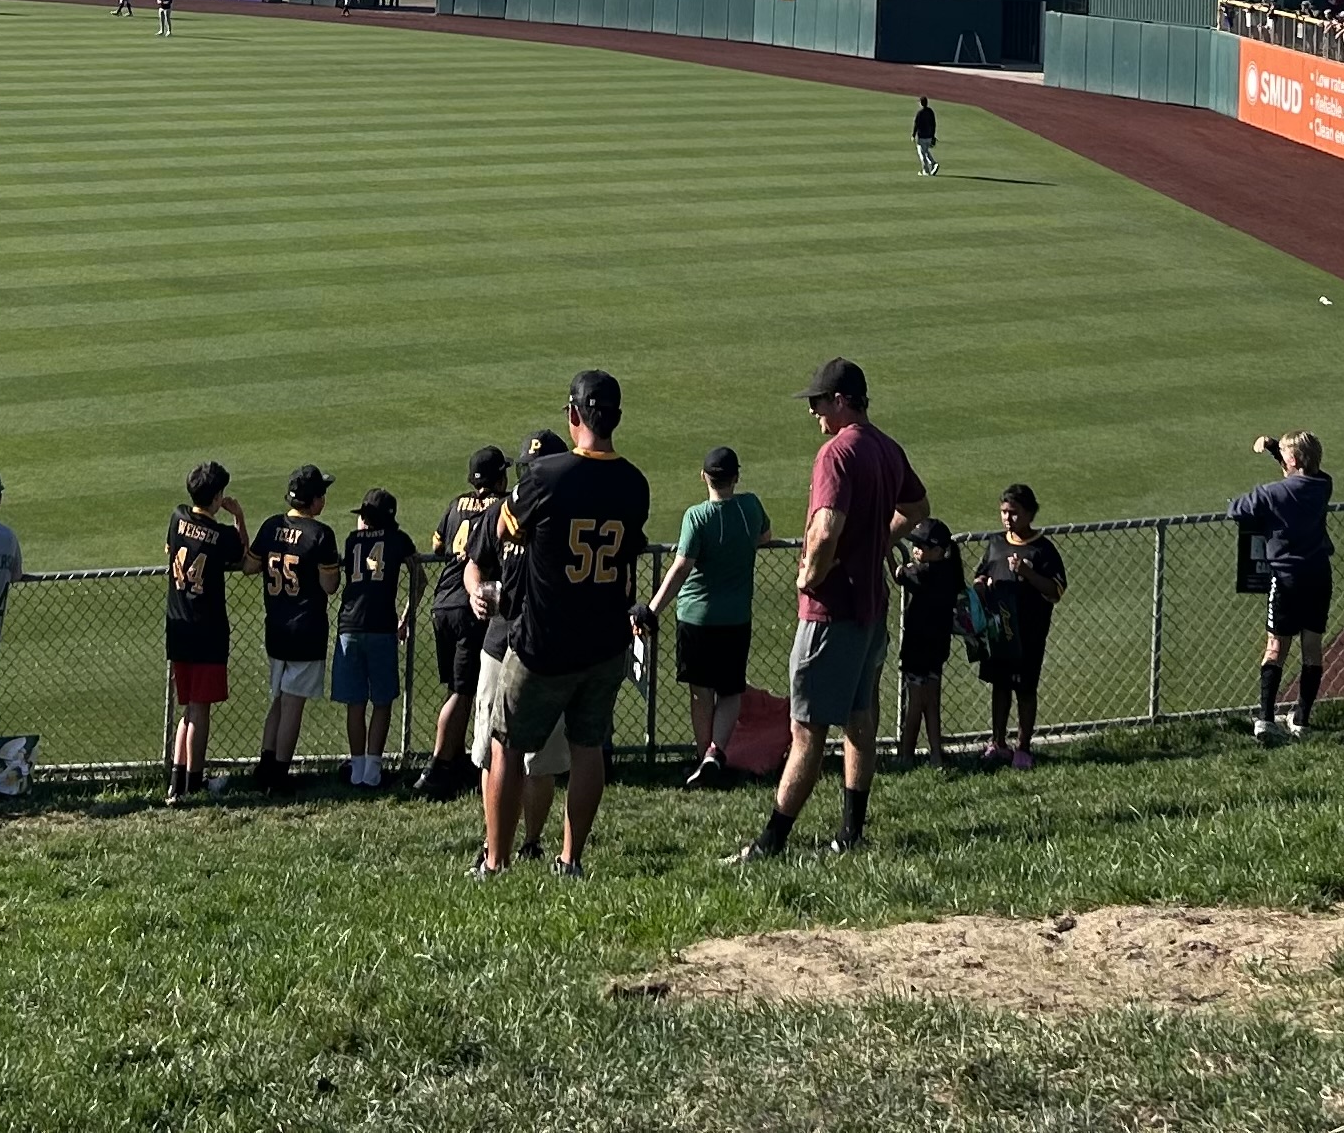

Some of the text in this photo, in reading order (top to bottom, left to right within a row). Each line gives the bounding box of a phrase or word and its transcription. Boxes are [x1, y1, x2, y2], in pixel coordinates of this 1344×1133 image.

[1260, 71, 1302, 114] SMUD
[1315, 69, 1331, 89] Low
[1315, 93, 1342, 118] Reliable
[1314, 118, 1334, 142] Clean
[528, 438, 542, 454] P
[173, 546, 207, 595] 44
[351, 541, 385, 583] 14
[565, 518, 624, 584] 52
[267, 551, 300, 596] 55
